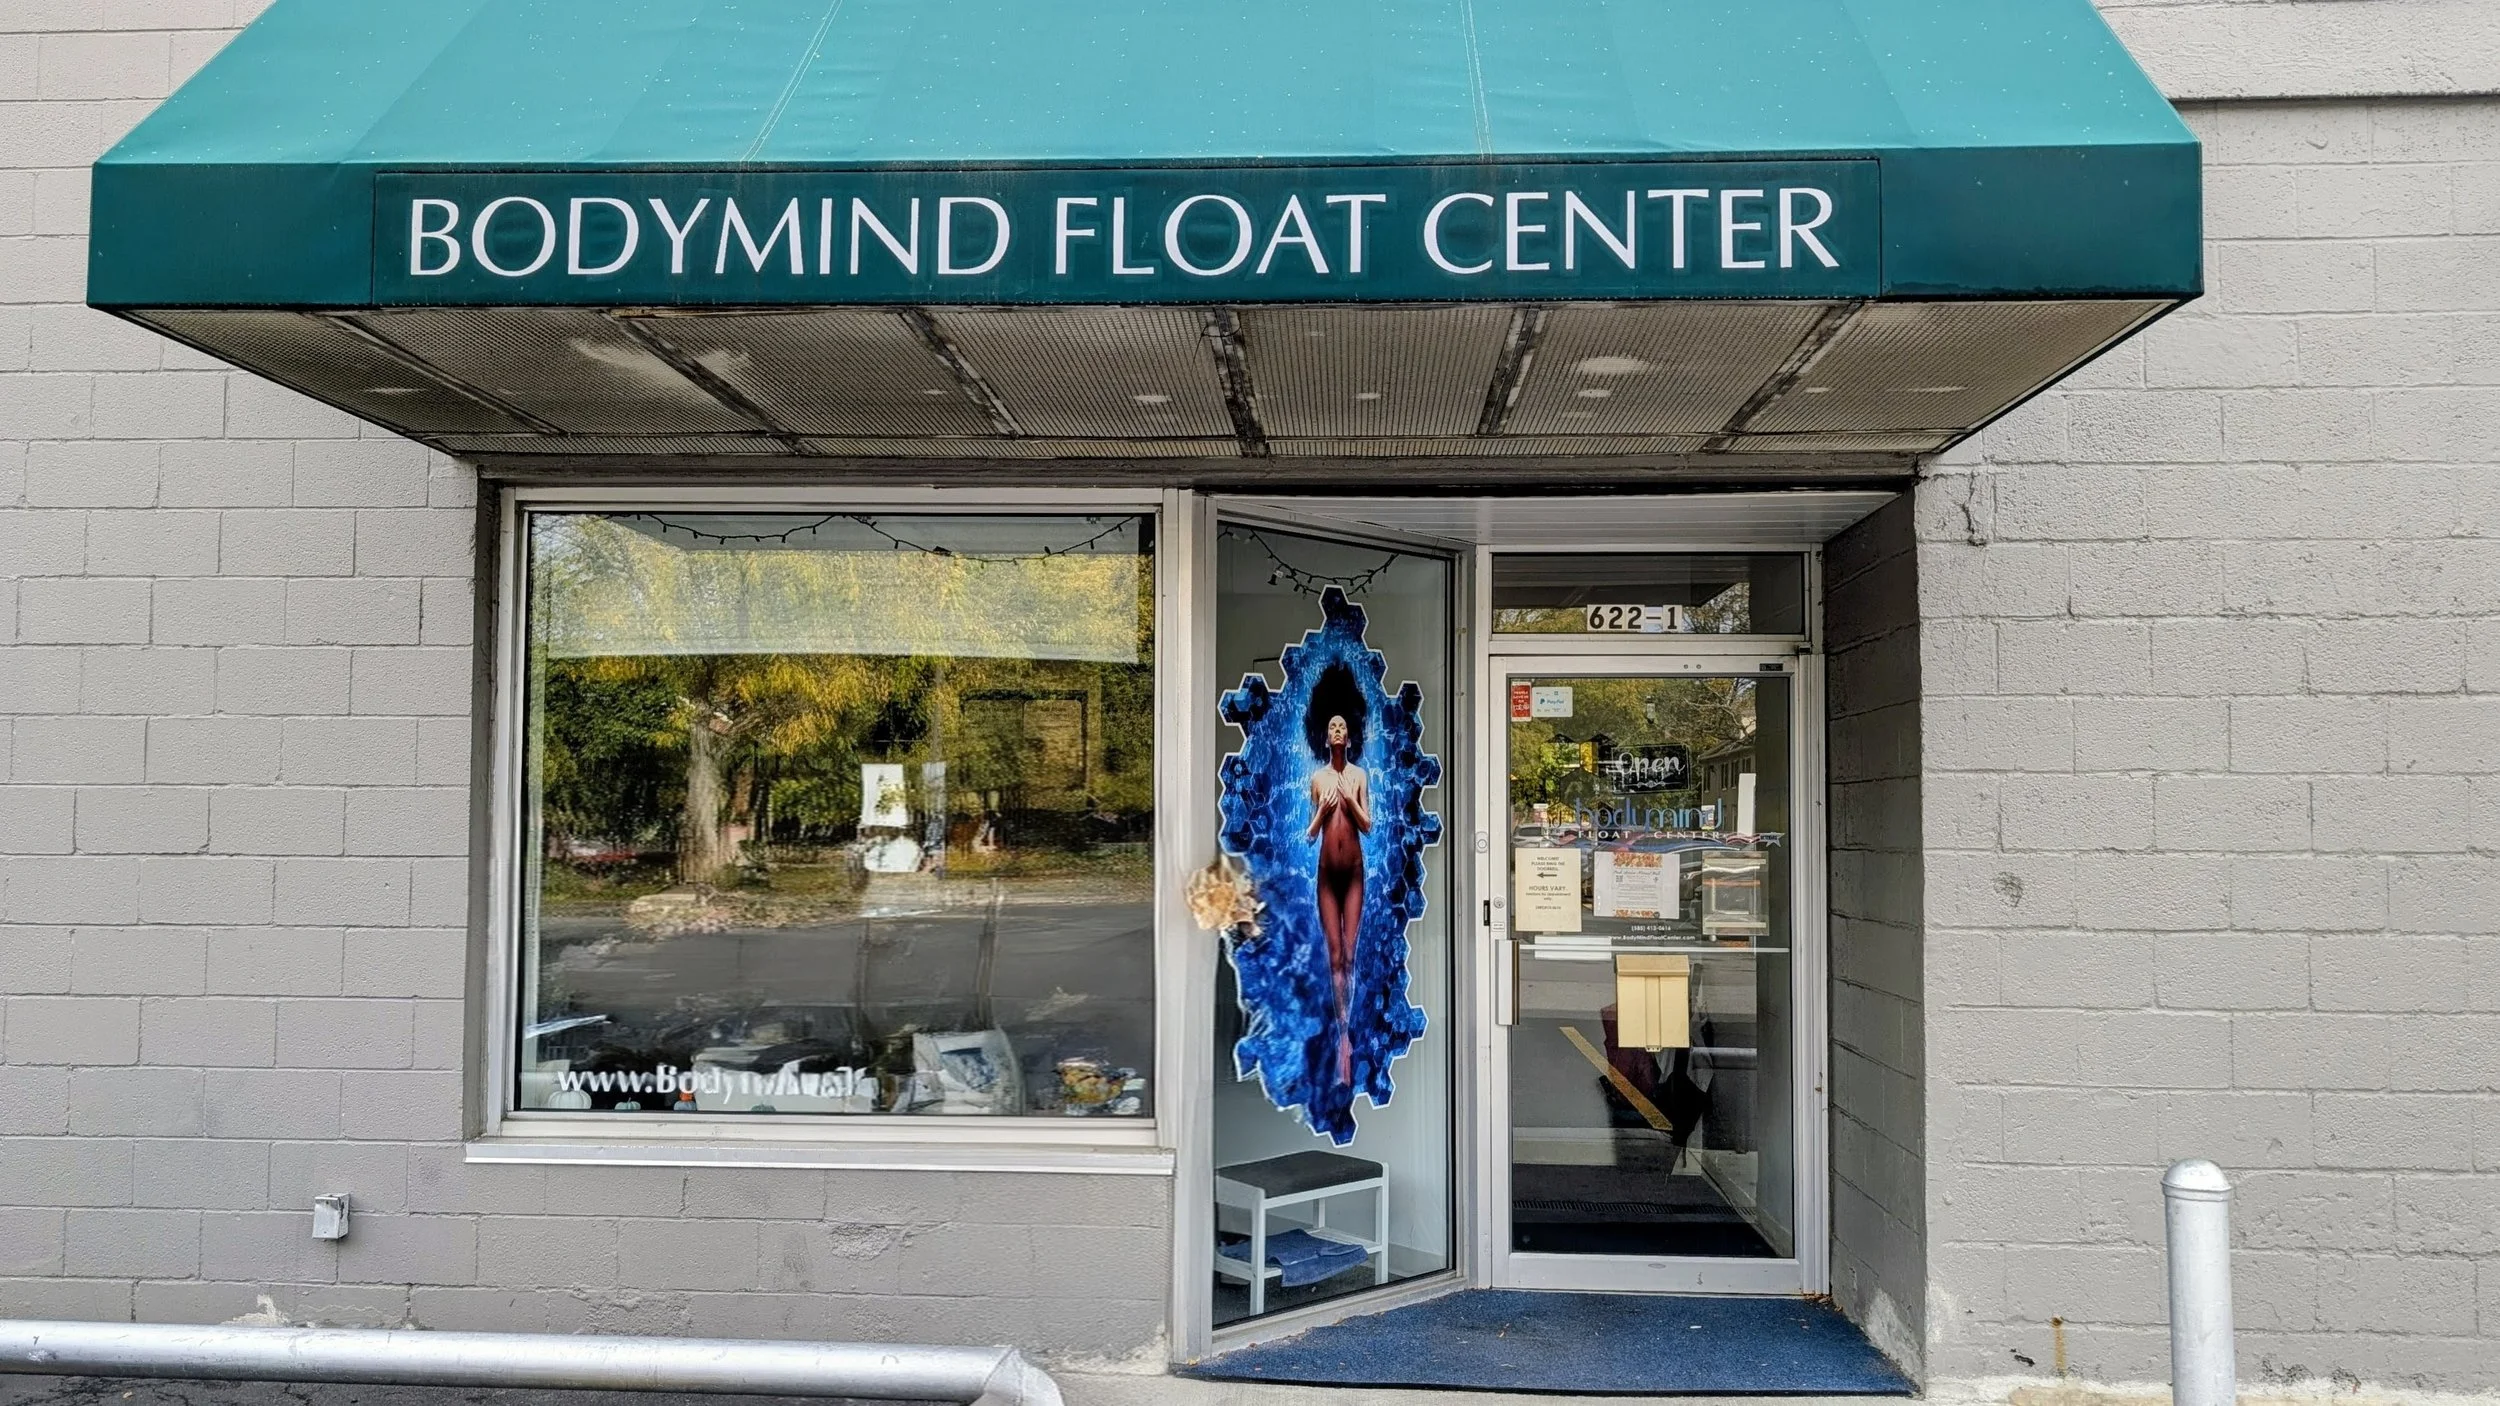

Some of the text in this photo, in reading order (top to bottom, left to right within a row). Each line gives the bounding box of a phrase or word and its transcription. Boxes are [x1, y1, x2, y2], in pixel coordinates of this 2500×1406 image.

[410, 188, 1840, 276] BODYMIND FLOAT CENTER
[1589, 606, 1677, 629] 622-1
[1615, 752, 1686, 782] Open
[1578, 830, 1720, 839] FLOAT CENTER
